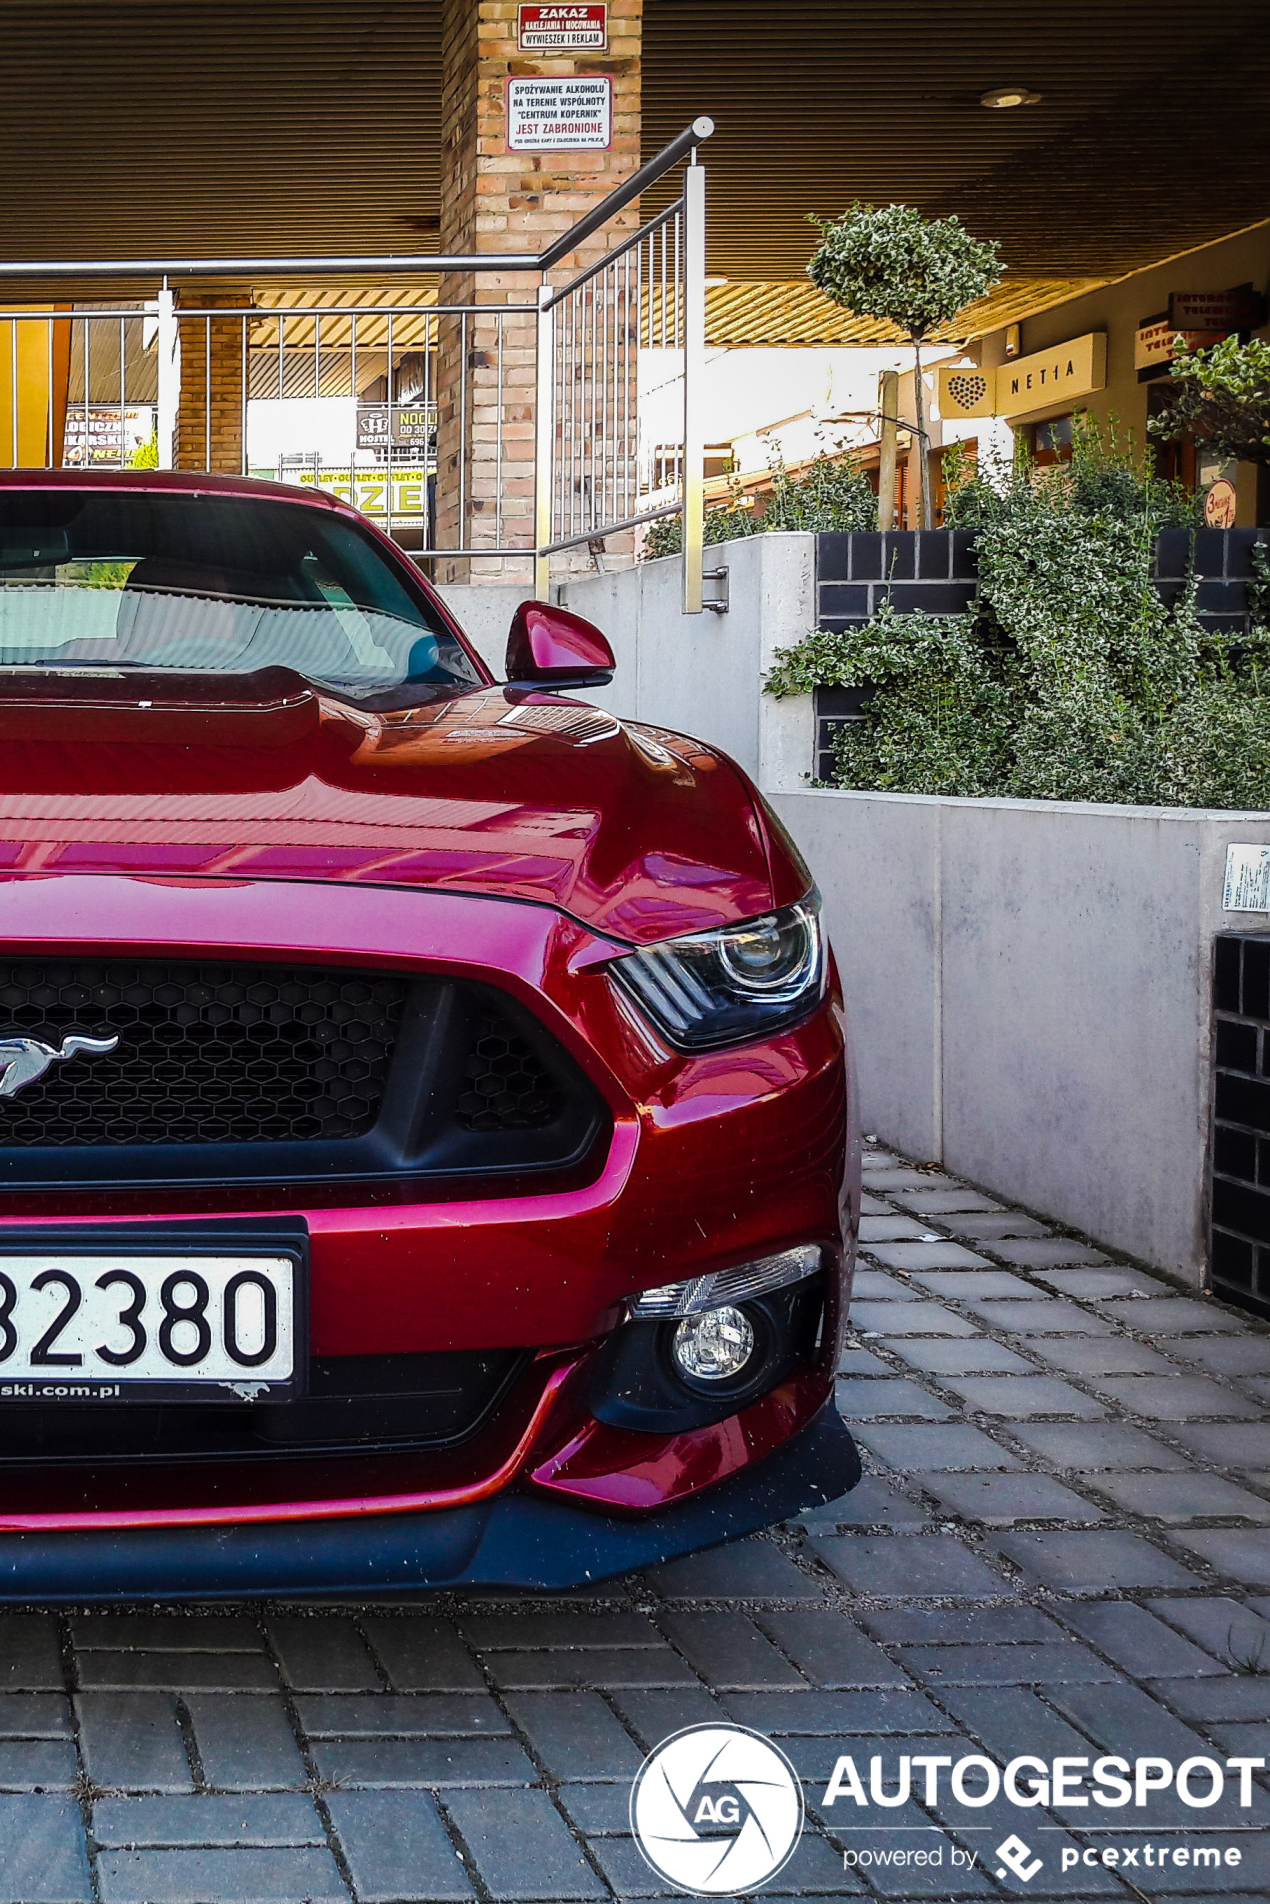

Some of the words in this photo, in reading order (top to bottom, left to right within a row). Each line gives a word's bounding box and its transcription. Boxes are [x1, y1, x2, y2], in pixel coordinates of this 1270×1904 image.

[539, 8, 588, 18] ZAKAZ
[525, 21, 561, 31] NAKLEJANIA
[565, 20, 601, 30] MOCOWANIA
[526, 34, 565, 44] WYWIESZEK
[571, 33, 600, 43] REKLAM
[515, 84, 563, 95] SPOŻYWANIE
[565, 84, 605, 94] ALKOHOLU
[513, 98, 524, 107] NA
[526, 98, 558, 107] TERENIE
[559, 95, 606, 106] WSPÓLNOTY
[516, 123, 539, 135] JEST
[542, 122, 603, 134] ZABRONIONE
[1011, 360, 1073, 394] NETIA
[400, 425, 413, 434] OD
[414, 425, 426, 434] 30
